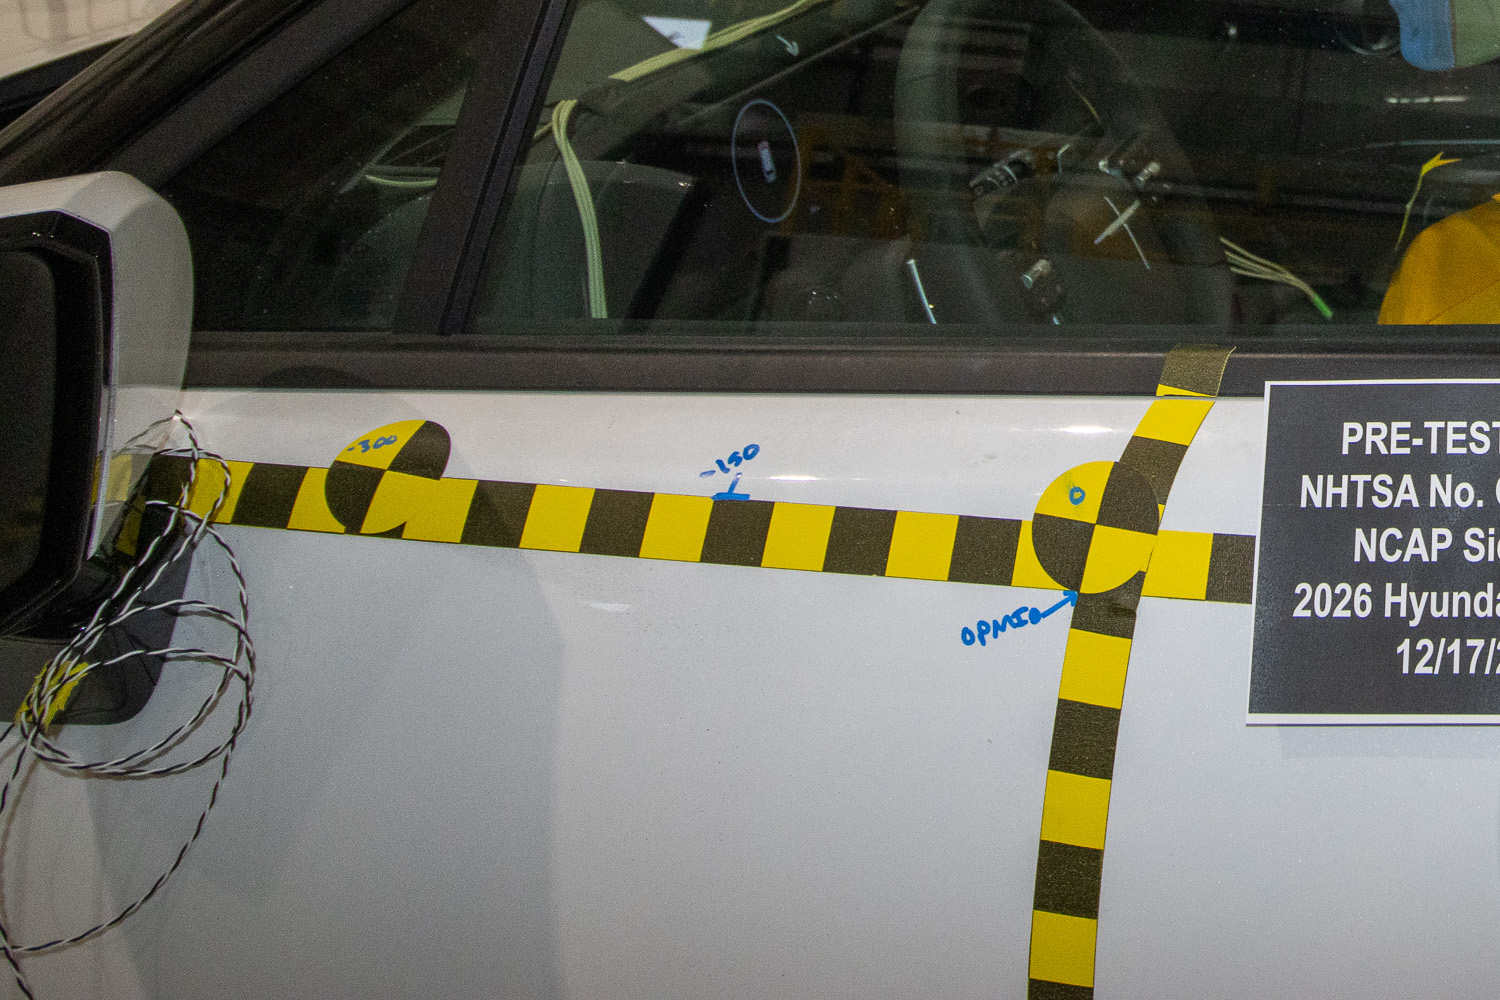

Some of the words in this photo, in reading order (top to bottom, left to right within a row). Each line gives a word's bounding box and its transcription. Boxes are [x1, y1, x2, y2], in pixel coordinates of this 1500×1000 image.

[1300, 473, 1420, 508] NHTSA
[1429, 473, 1484, 508] No.
[1353, 527, 1453, 563] NCAP
[1292, 582, 1373, 618] 2026
